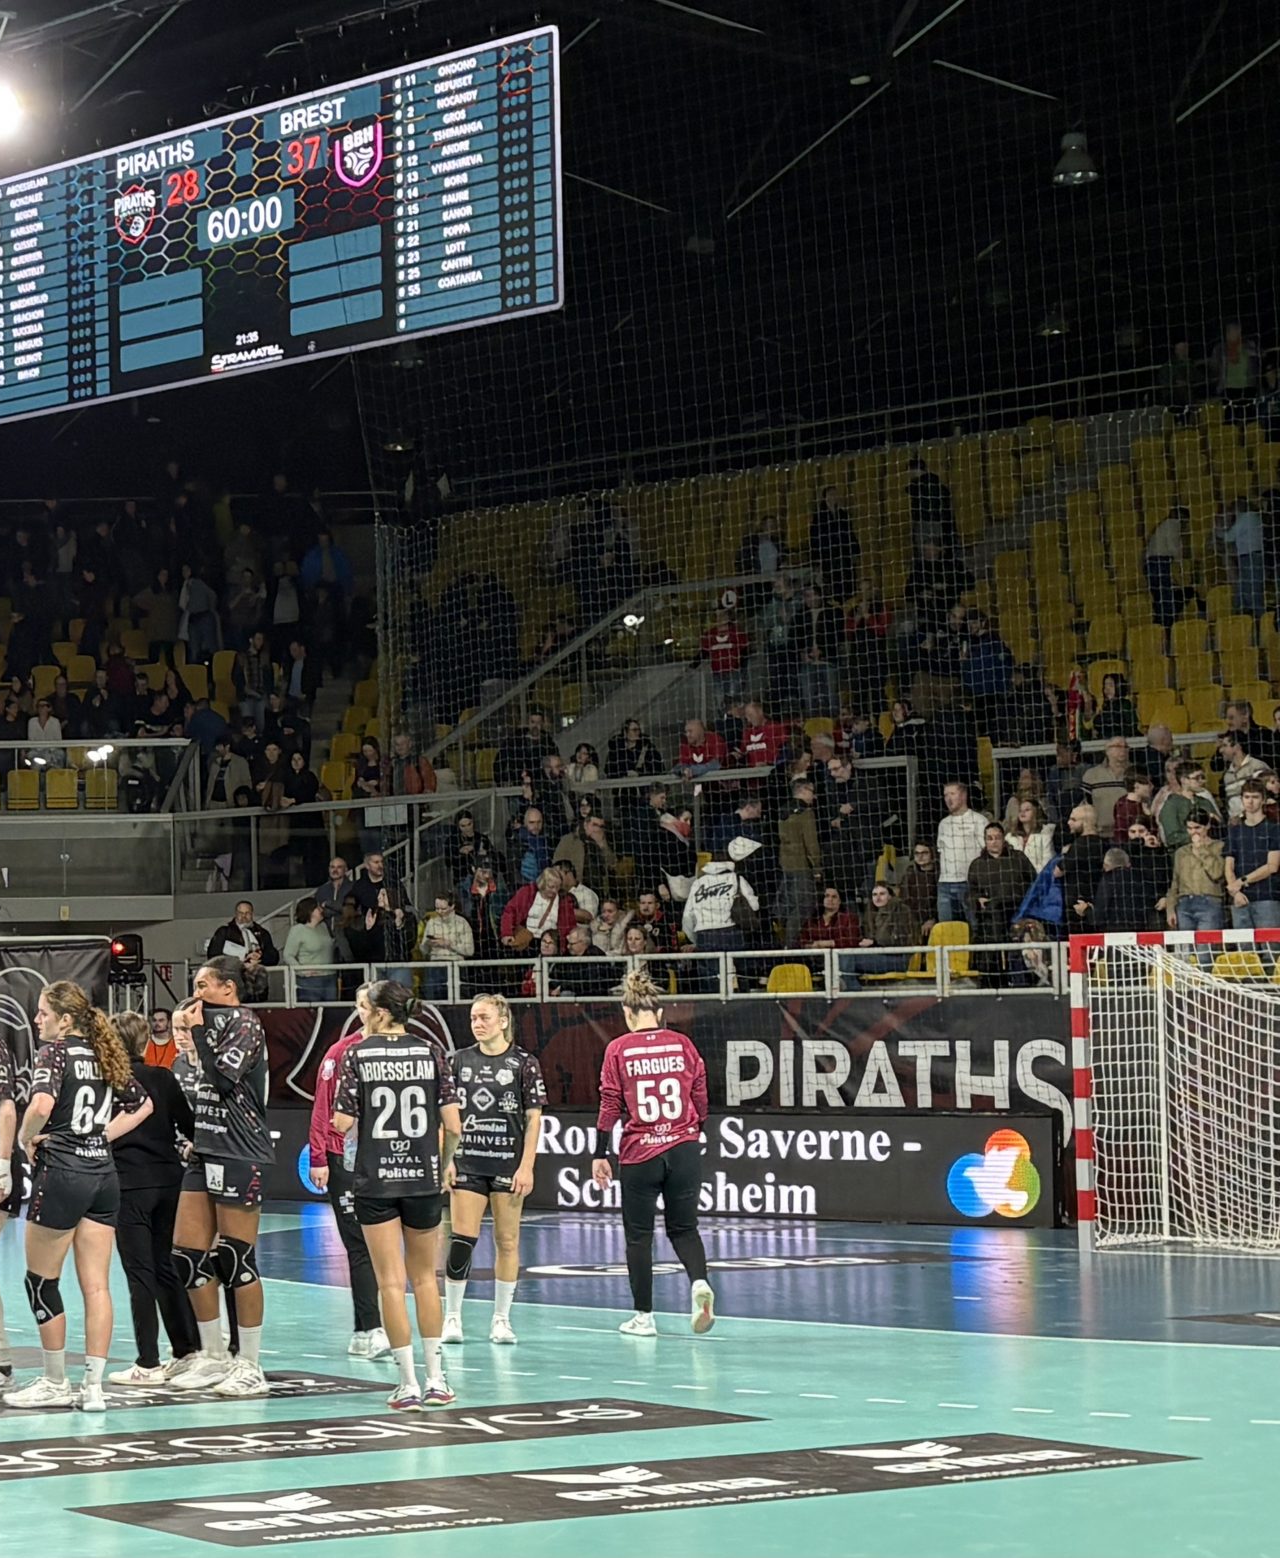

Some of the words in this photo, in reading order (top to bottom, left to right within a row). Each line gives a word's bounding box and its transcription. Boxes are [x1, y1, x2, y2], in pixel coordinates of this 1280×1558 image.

[405, 74, 416, 86] 11
[407, 106, 414, 117] 2
[437, 89, 478, 109] NOCANDY
[408, 91, 413, 101] 1
[280, 97, 346, 135] BREST
[443, 109, 466, 124] GROS
[343, 125, 374, 151] BBH
[116, 139, 195, 179] PIRATHS
[287, 136, 320, 174] 37
[407, 155, 418, 166] 12
[166, 169, 199, 207] 28
[407, 171, 418, 183] 13
[114, 189, 156, 216] PIRATHS
[407, 187, 418, 199] 14
[207, 196, 282, 243] 60:00
[408, 203, 419, 215] 15
[407, 220, 418, 232] 21
[407, 235, 419, 247] 22
[408, 251, 419, 264] 23
[445, 241, 466, 255] LOTT
[408, 267, 420, 280] 25
[408, 284, 420, 296] 55
[211, 344, 284, 367] STRAMATEL
[360, 1059, 435, 1082] ABDESSELAM
[625, 1056, 686, 1077] FARGUES
[636, 1078, 683, 1123] 53
[726, 1039, 1073, 1148] PIRATHS
[71, 1085, 113, 1135] 64
[371, 1085, 428, 1139] 26
[720, 1116, 891, 1163] Saverne
[380, 1156, 422, 1164] DUVAL
[377, 1167, 425, 1179] Politec
[873, 1449, 1096, 1474] erima
[555, 1477, 799, 1501] erima
[204, 1504, 469, 1531] erima
